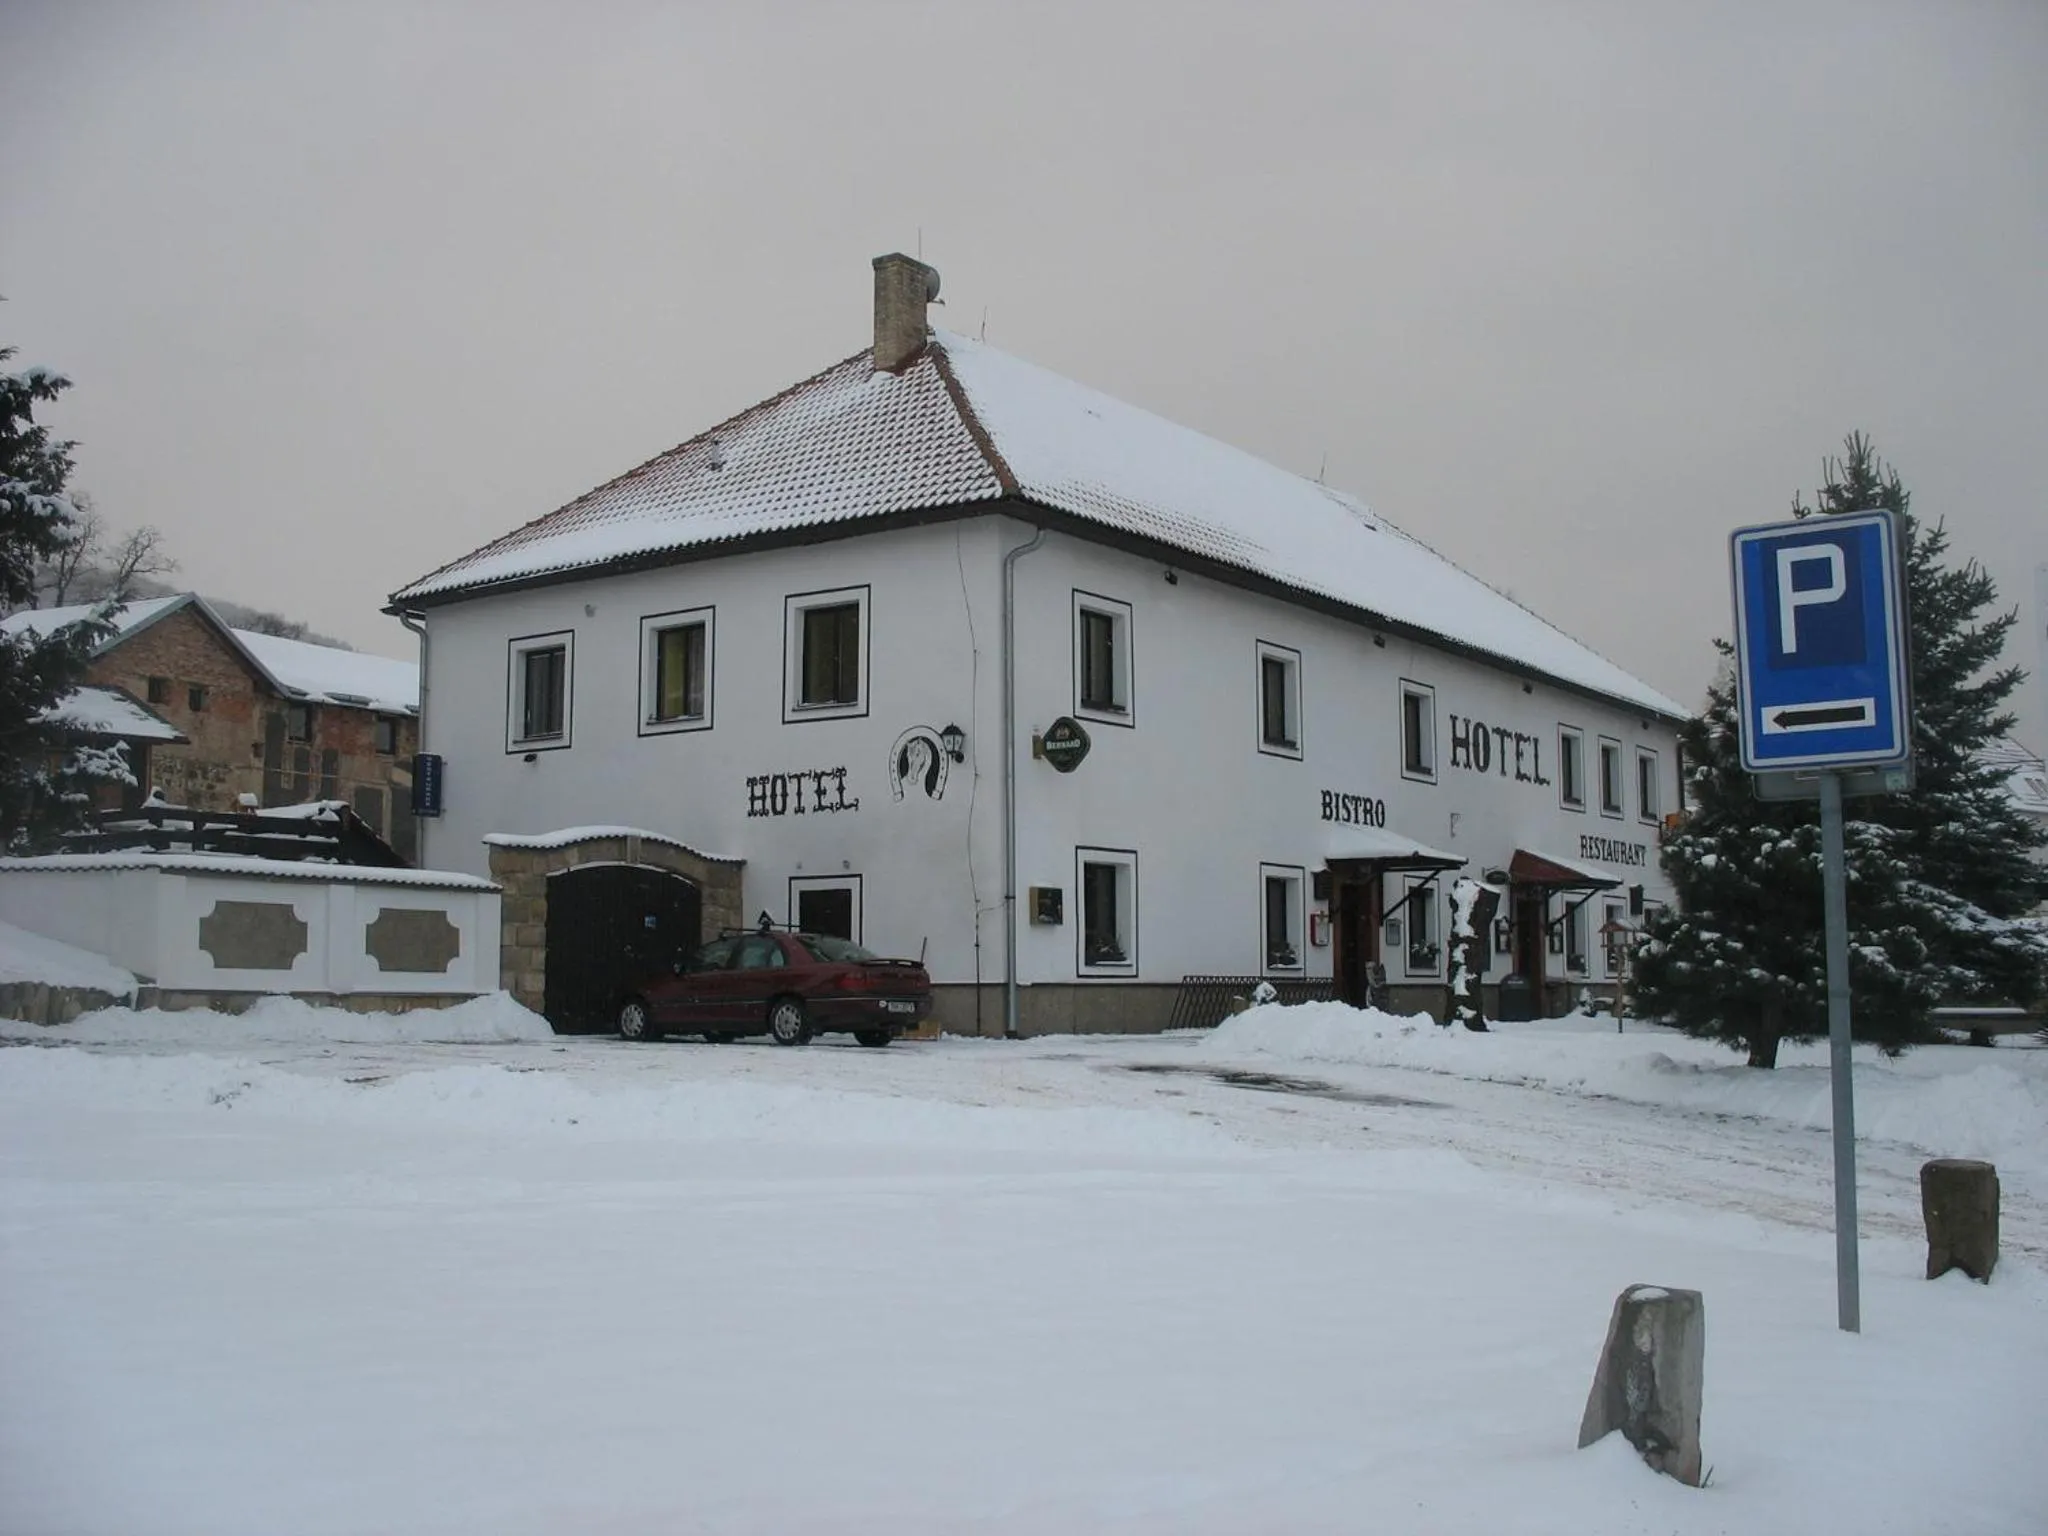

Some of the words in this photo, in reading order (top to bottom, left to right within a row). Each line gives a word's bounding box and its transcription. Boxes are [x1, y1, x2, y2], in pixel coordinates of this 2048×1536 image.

[1776, 543, 1847, 654] P
[1449, 713, 1551, 787] HOTEL
[746, 766, 860, 818] HOTEL
[1320, 789, 1386, 829] BISTRO
[1579, 834, 1647, 868] RESTAURANT
